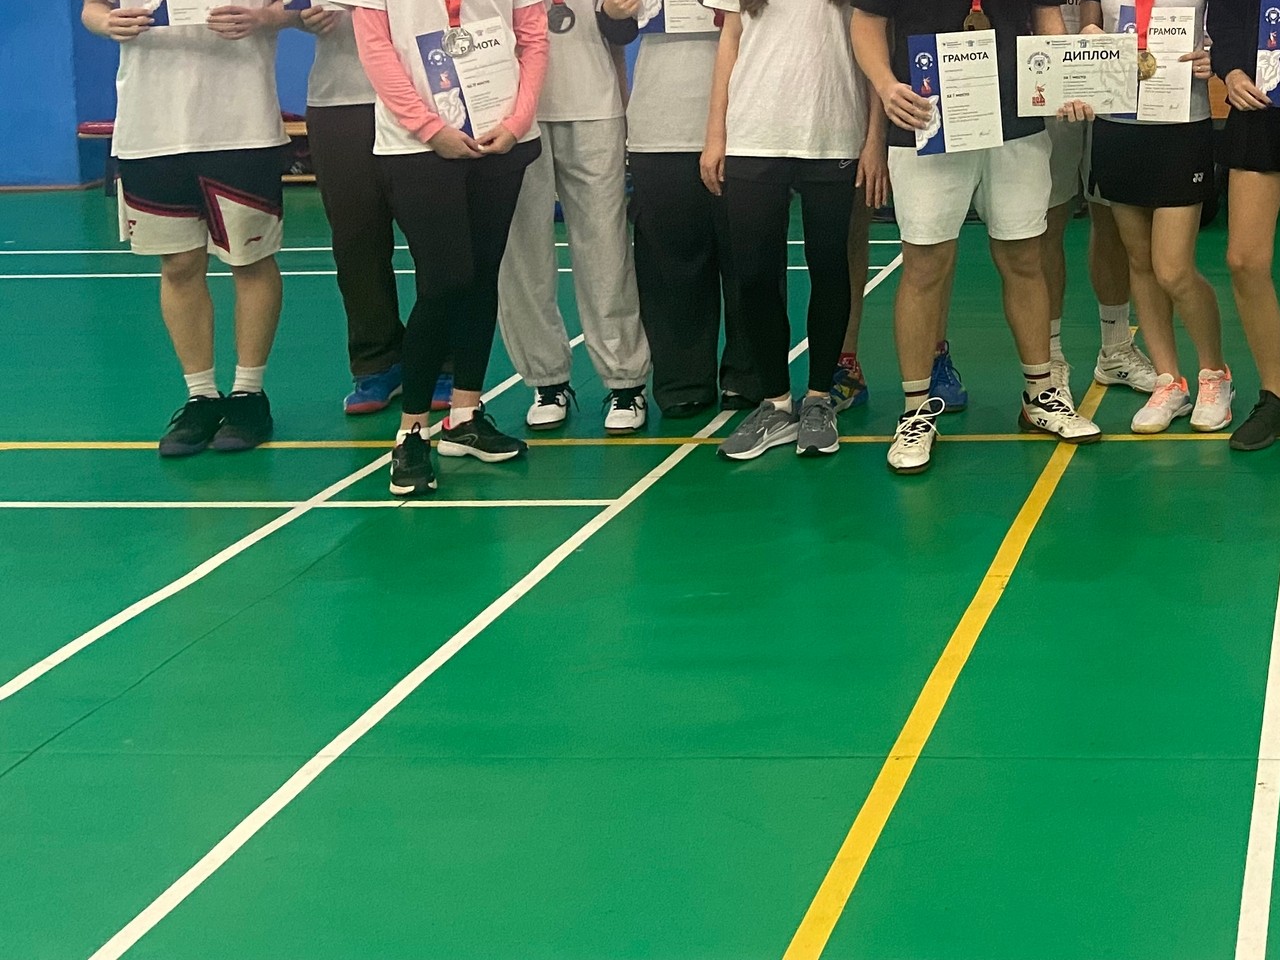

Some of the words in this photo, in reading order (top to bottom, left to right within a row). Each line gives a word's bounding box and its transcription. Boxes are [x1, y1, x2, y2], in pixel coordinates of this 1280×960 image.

[1148, 27, 1187, 36] ГРАМОТА
[460, 38, 501, 53] РМОТА
[942, 51, 989, 63] ГРАМОТА
[1062, 50, 1120, 63] ДИПЛОМ
